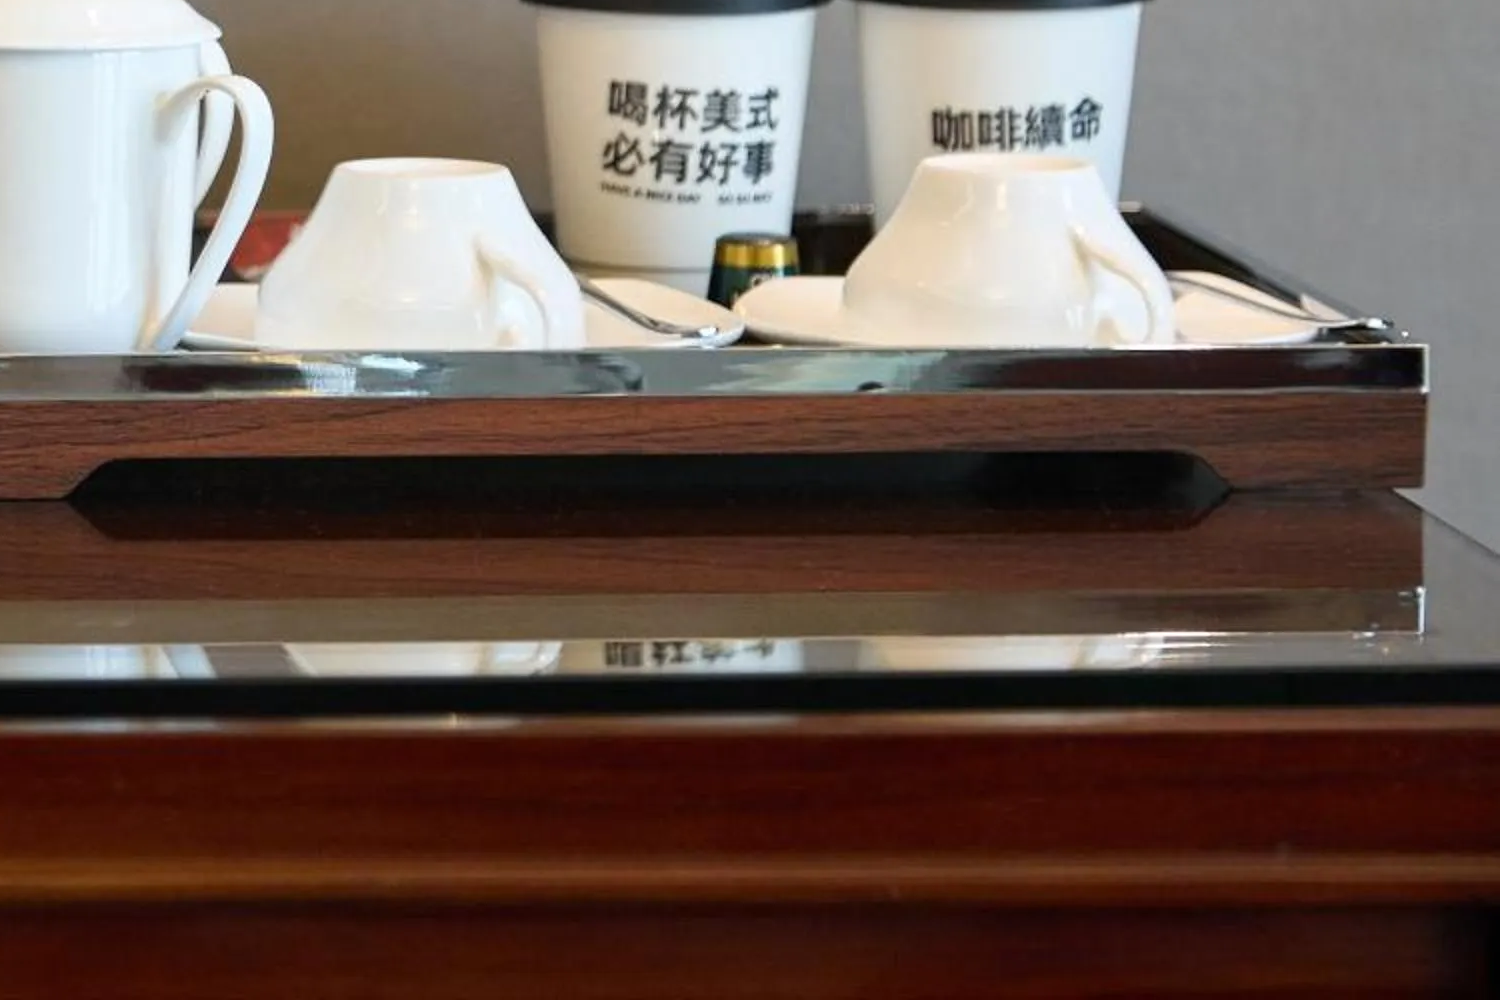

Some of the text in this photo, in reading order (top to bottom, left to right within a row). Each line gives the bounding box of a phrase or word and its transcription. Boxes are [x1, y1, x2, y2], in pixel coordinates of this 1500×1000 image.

[607, 80, 781, 133] 喝杯美式
[930, 96, 1104, 152] 咖啡續命
[602, 134, 776, 187] 必有好事
